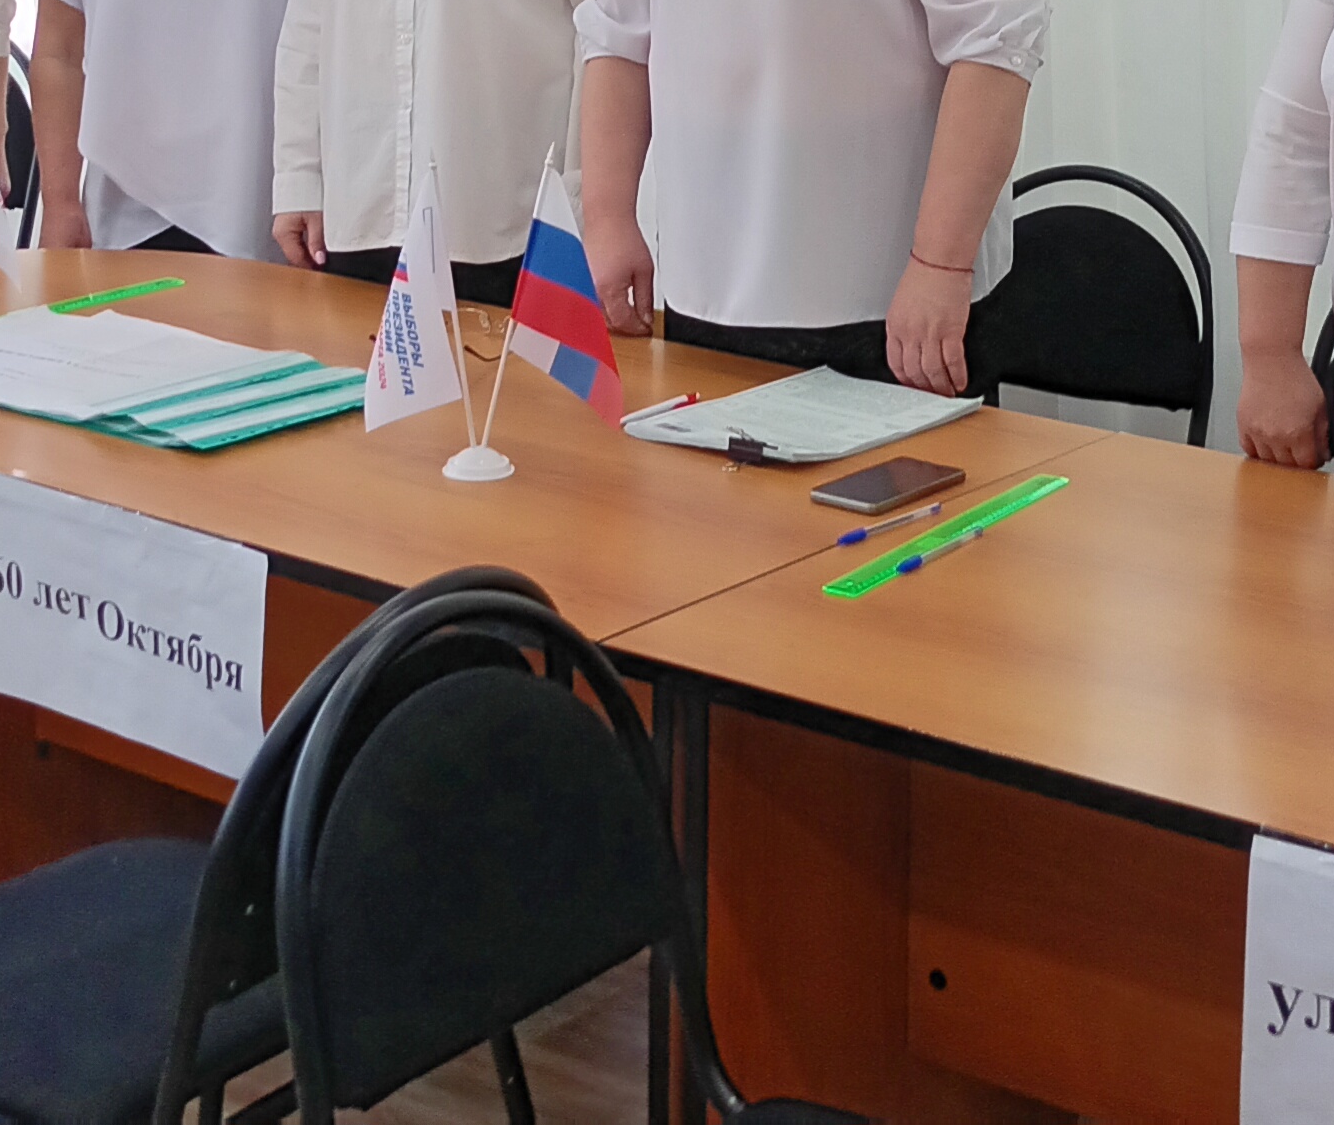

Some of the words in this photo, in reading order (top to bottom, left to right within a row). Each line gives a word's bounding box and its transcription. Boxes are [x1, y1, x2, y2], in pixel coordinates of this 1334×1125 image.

[392, 288, 416, 396] ПРЕЗИДЕНТА
[401, 292, 425, 369] ВЫБОРЫ
[32, 580, 91, 621] лет
[96, 599, 244, 693] Октября
